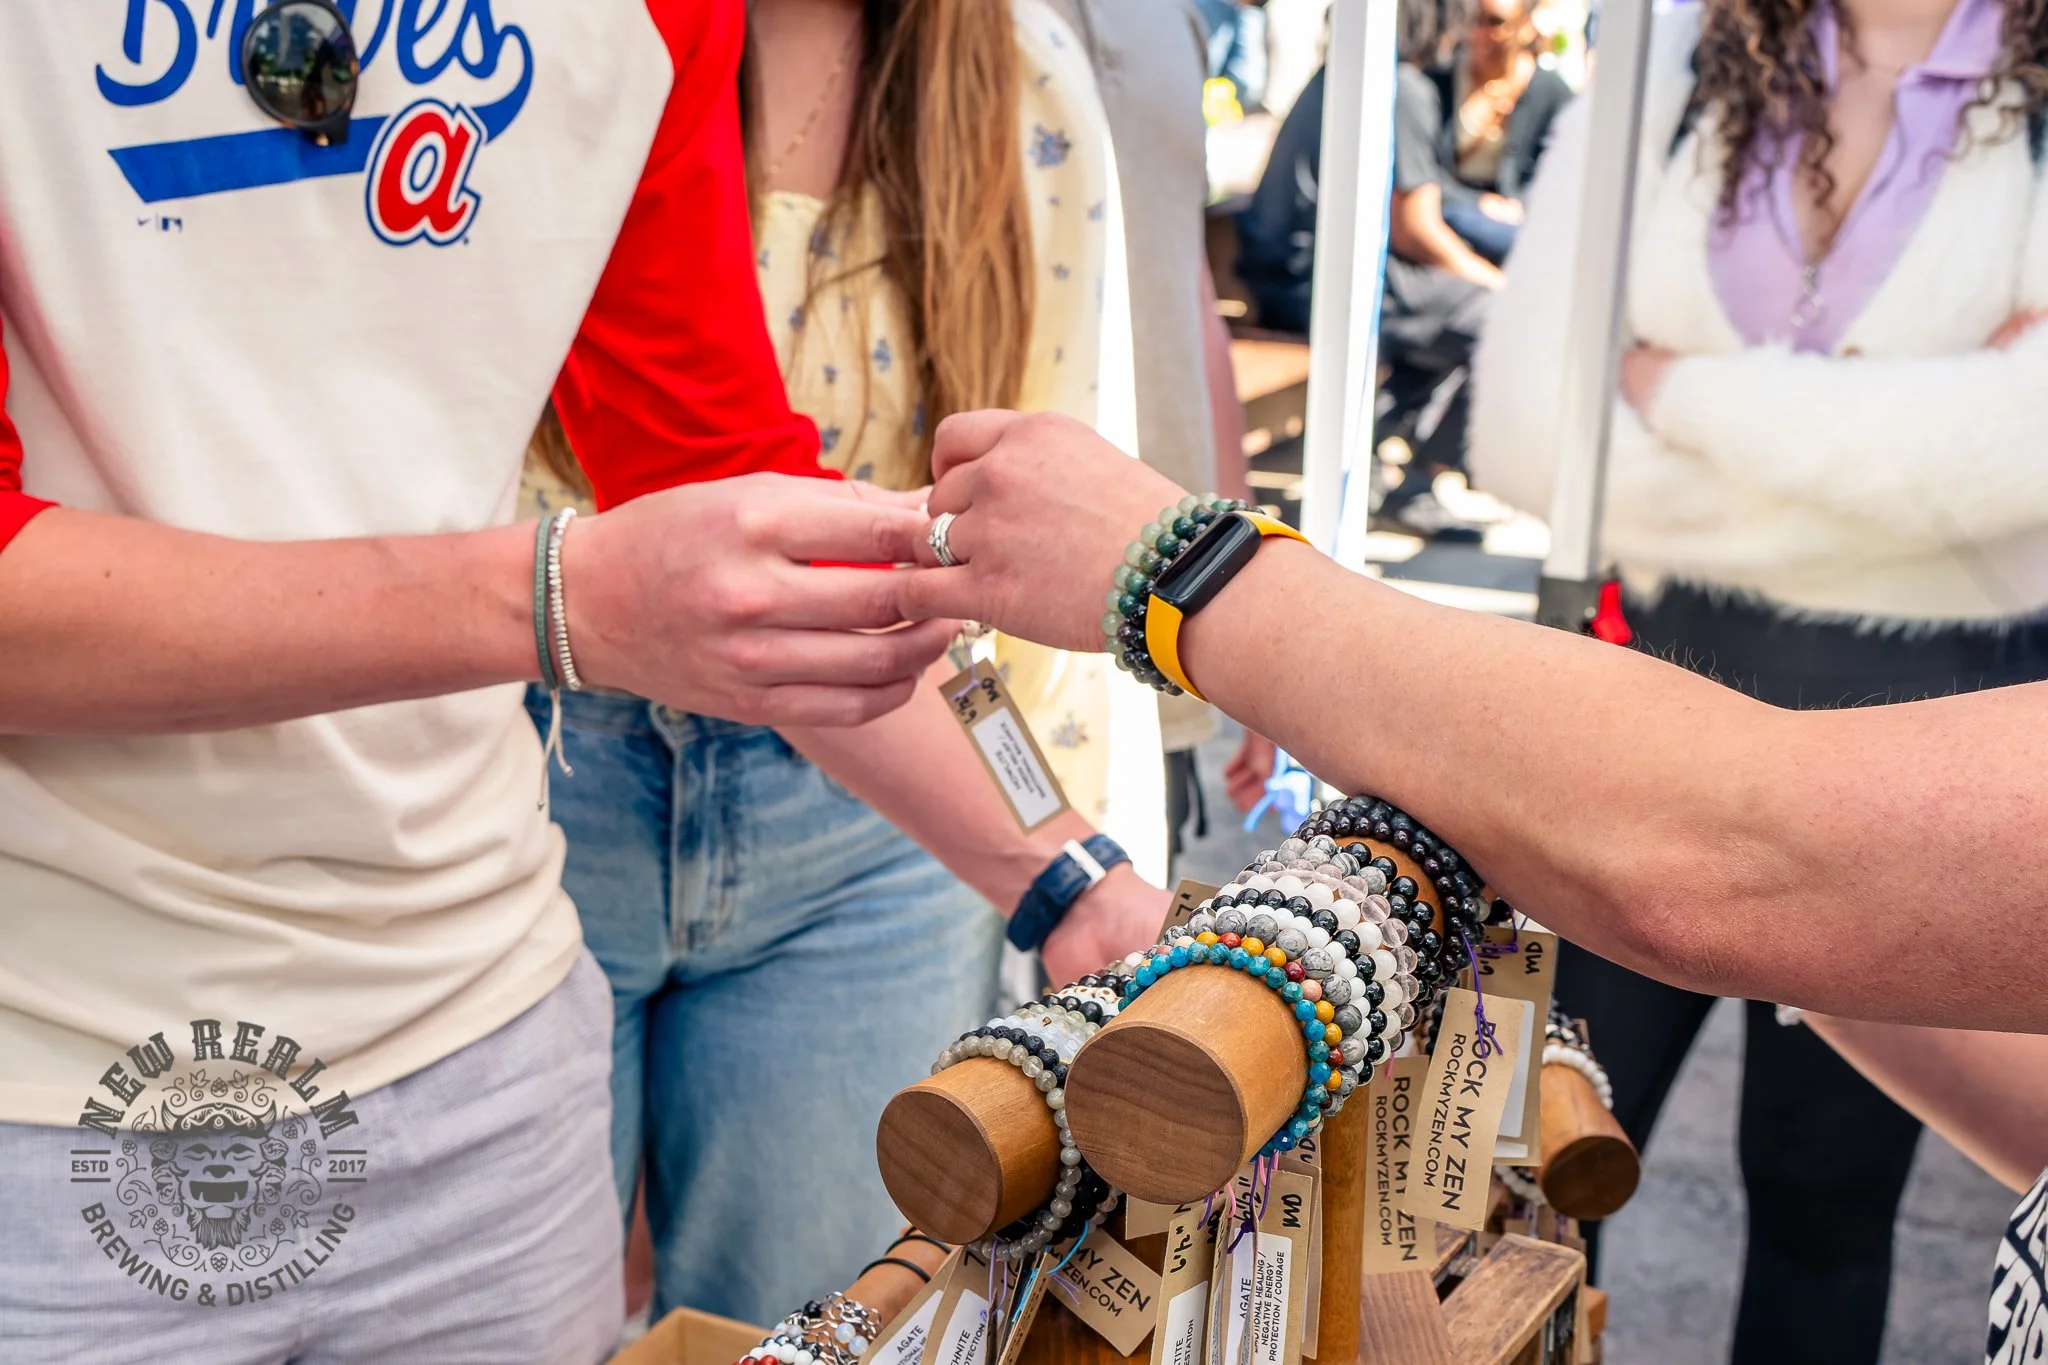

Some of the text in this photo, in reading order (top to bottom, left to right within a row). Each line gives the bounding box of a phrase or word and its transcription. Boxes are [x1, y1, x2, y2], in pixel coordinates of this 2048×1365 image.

[1391, 1076, 1412, 1151] ROCK
[1423, 1033, 1467, 1188] ROCKMYZEN.COM
[1440, 1019, 1497, 1211] ROCK MY ZEN
[1375, 1095, 1394, 1246] ROCKMYZEN.COM
[1396, 1208, 1419, 1262] ZEN
[1101, 1266, 1152, 1313] ZEN
[1240, 1277, 1252, 1319] AGATE
[1255, 1259, 1265, 1298] HEALING
[1274, 1251, 1285, 1296] COURAGE
[1262, 1262, 1274, 1346] NEGATIVE ENERGY
[896, 1325, 924, 1354] AGATE
[1269, 1304, 1281, 1362] PROTECTION
